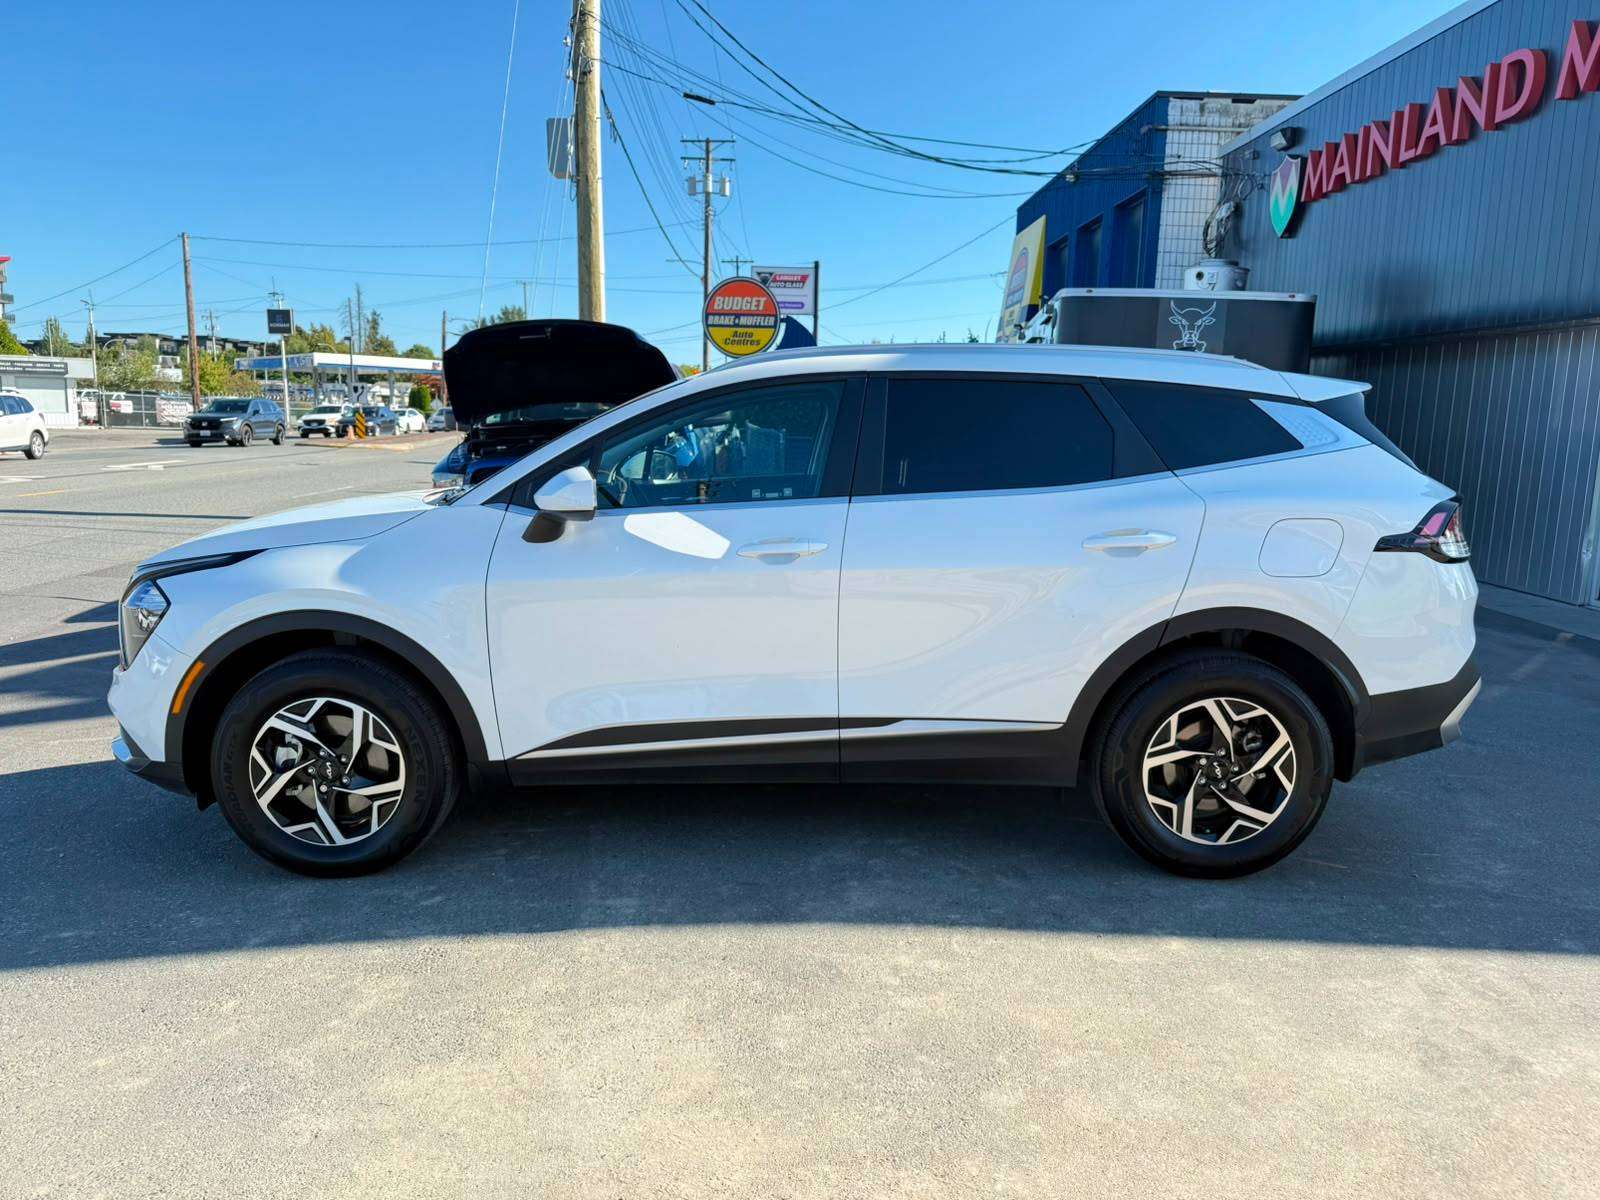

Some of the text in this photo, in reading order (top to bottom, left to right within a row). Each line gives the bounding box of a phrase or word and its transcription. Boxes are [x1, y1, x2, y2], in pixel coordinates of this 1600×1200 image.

[1301, 48, 1548, 202] MAINLAND
[714, 296, 767, 311] BUDGET
[732, 330, 754, 338] Auto
